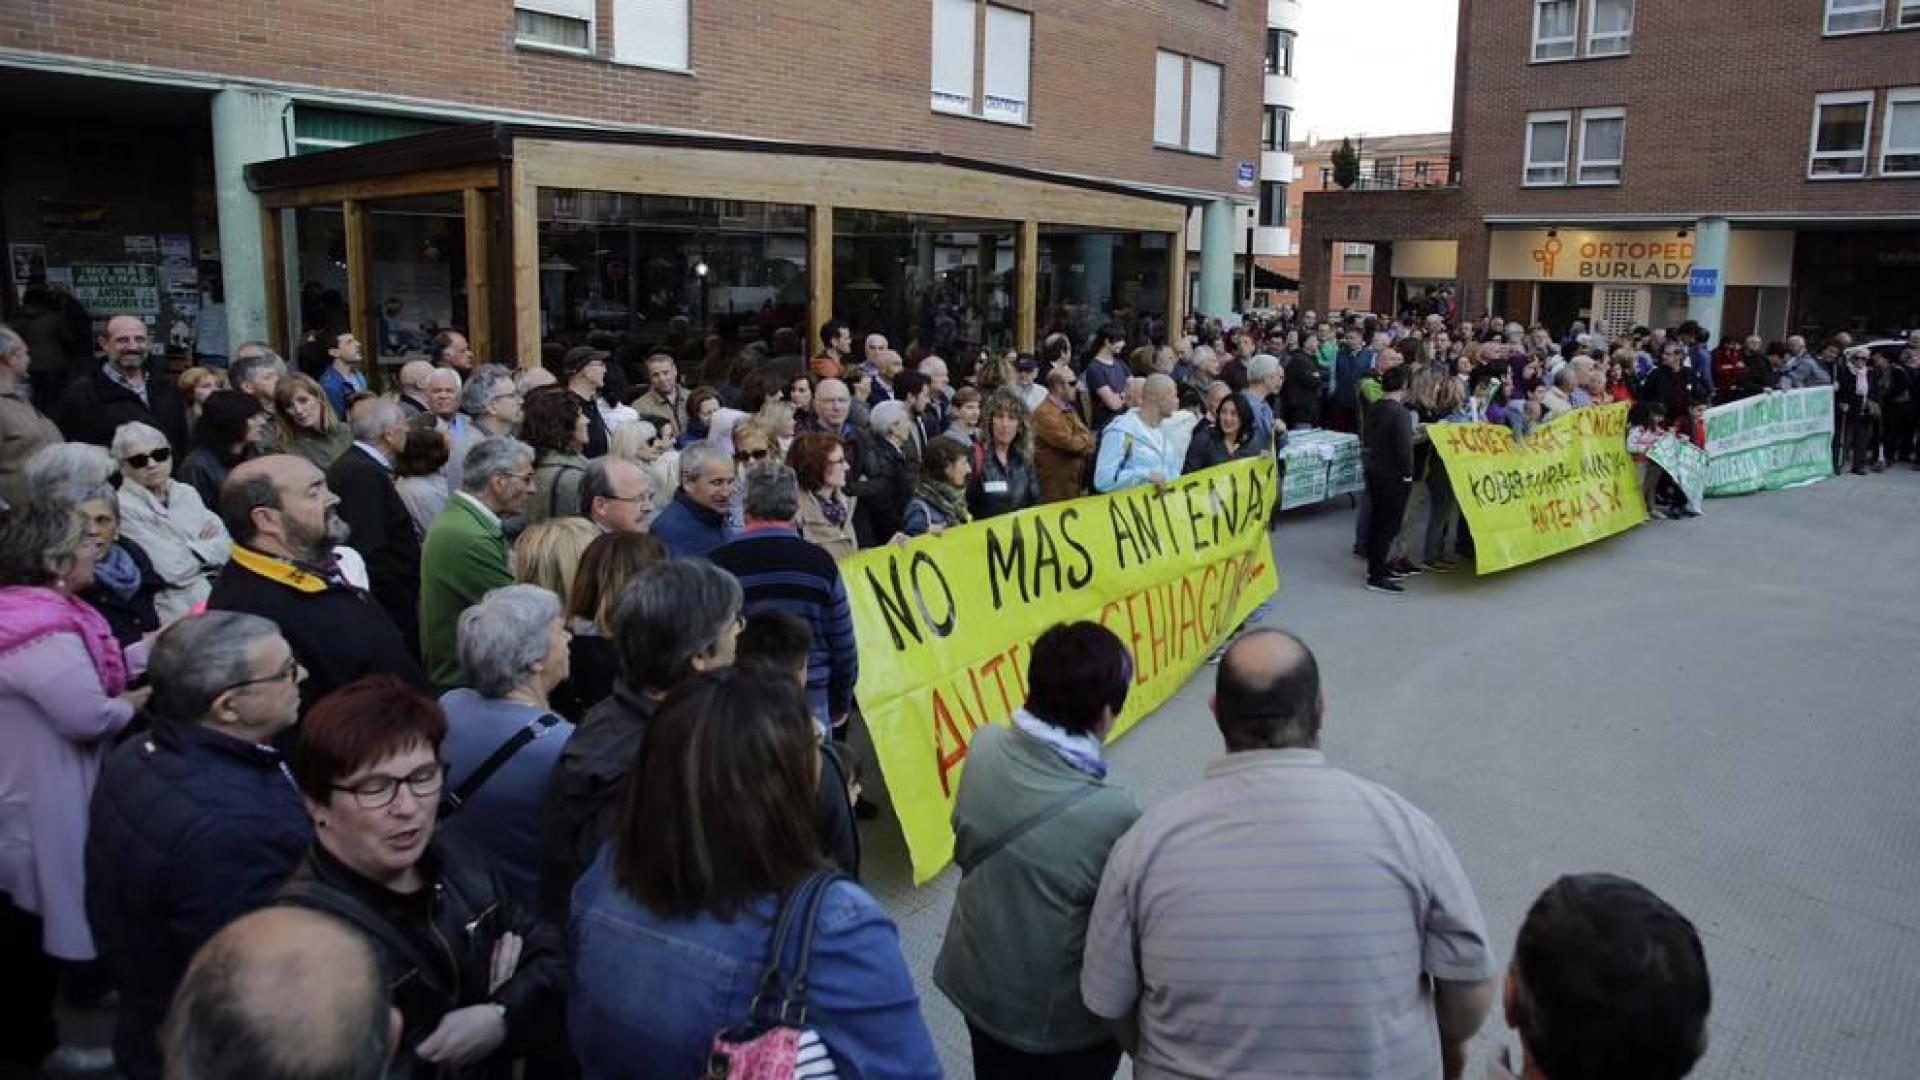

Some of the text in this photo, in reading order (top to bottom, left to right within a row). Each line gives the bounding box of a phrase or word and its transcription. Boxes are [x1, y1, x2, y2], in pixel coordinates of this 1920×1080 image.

[864, 549, 957, 652] NO
[985, 507, 1095, 611] MAS
[1107, 464, 1276, 571] ANTENA
[932, 640, 1036, 799] ANTE
